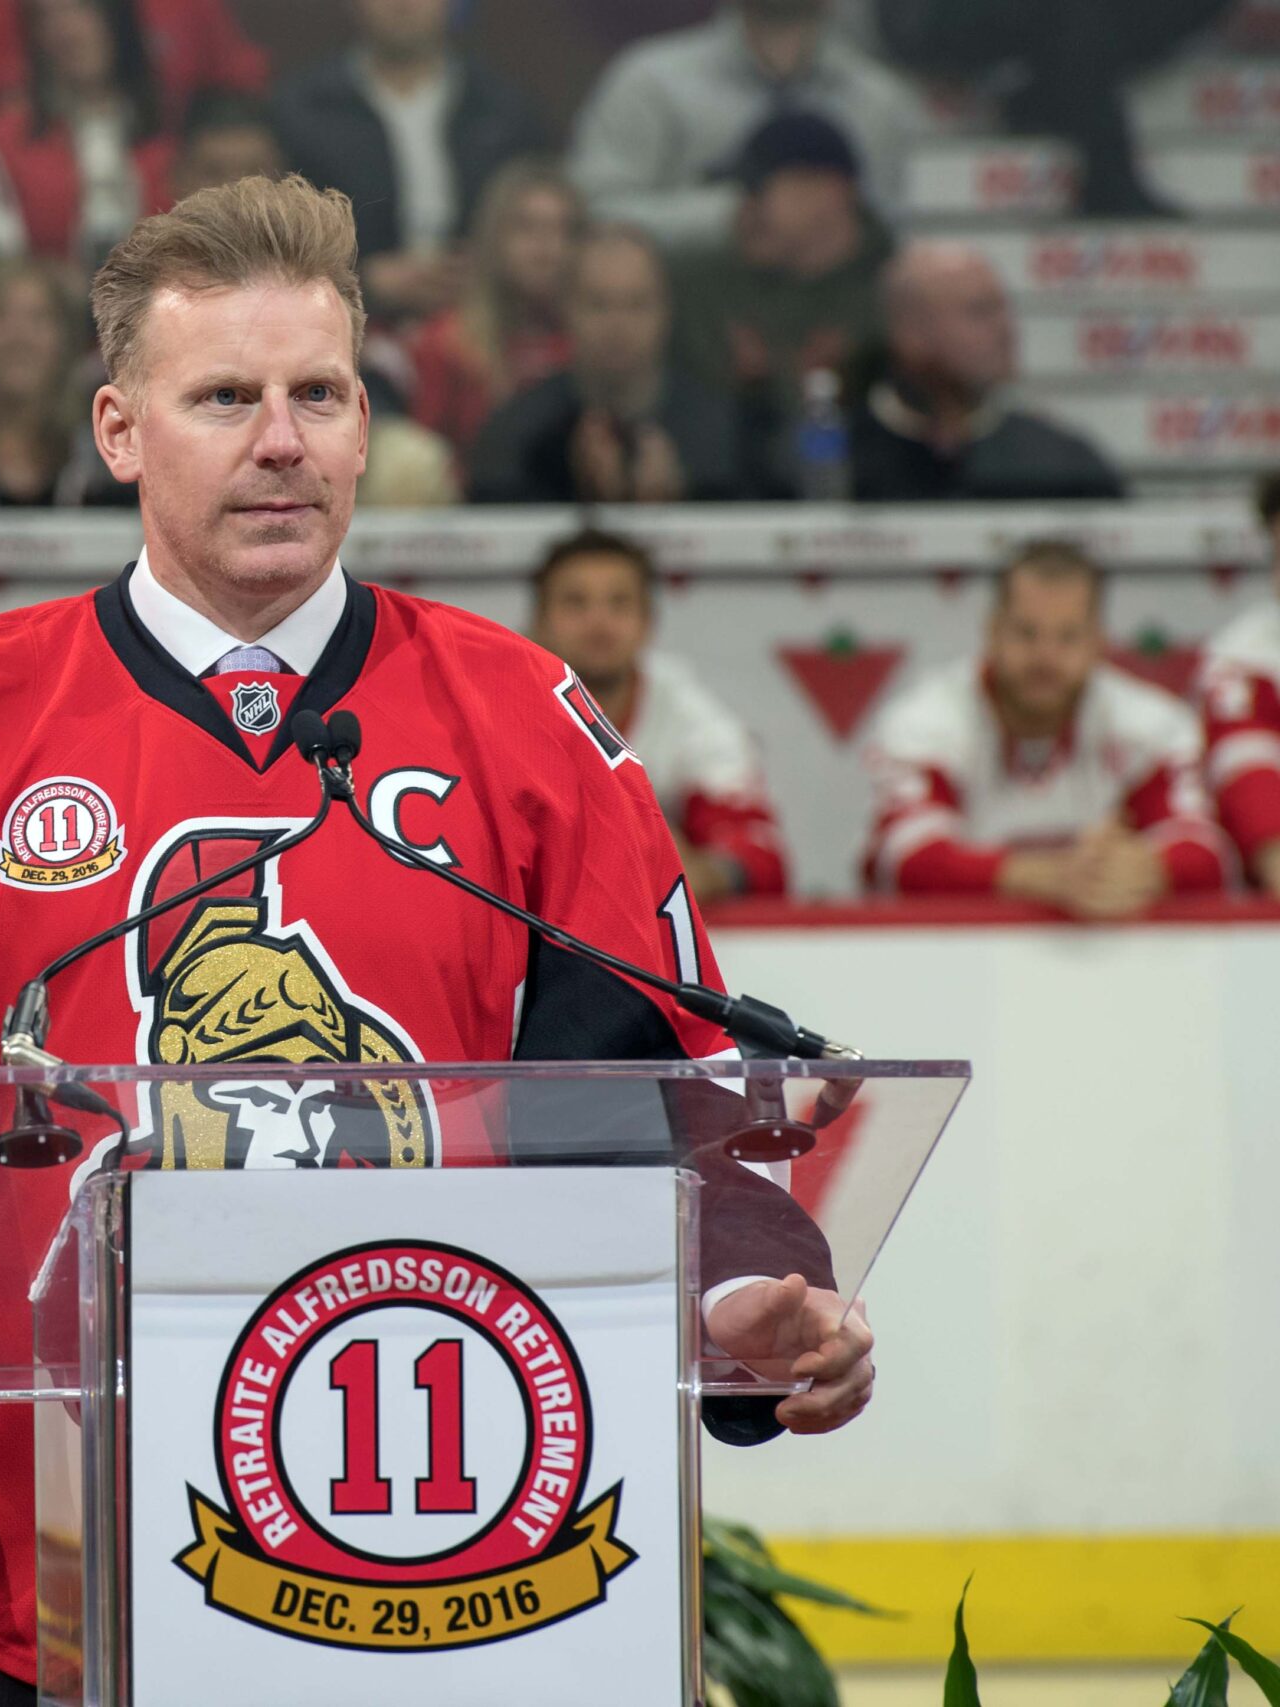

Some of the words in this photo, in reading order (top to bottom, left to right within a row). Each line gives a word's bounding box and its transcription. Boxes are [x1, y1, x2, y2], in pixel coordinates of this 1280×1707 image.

[243, 696, 270, 723] NHL
[12, 815, 32, 862] RETRAITE
[22, 786, 86, 814] ALFREDSSON
[85, 794, 107, 856] RETIREMENT
[39, 805, 81, 852] 11
[367, 766, 463, 871] C
[21, 868, 47, 881] DEC.
[51, 870, 68, 882] 29,
[72, 862, 99, 879] 2016
[261, 1257, 499, 1359] ALFREDSSON
[230, 1358, 299, 1549] RETRAITE
[330, 1338, 477, 1515] 11
[495, 1301, 577, 1548] RETIREMENT
[271, 1579, 356, 1633] DEC.
[372, 1599, 431, 1641] 29,
[443, 1579, 541, 1633] 2016
